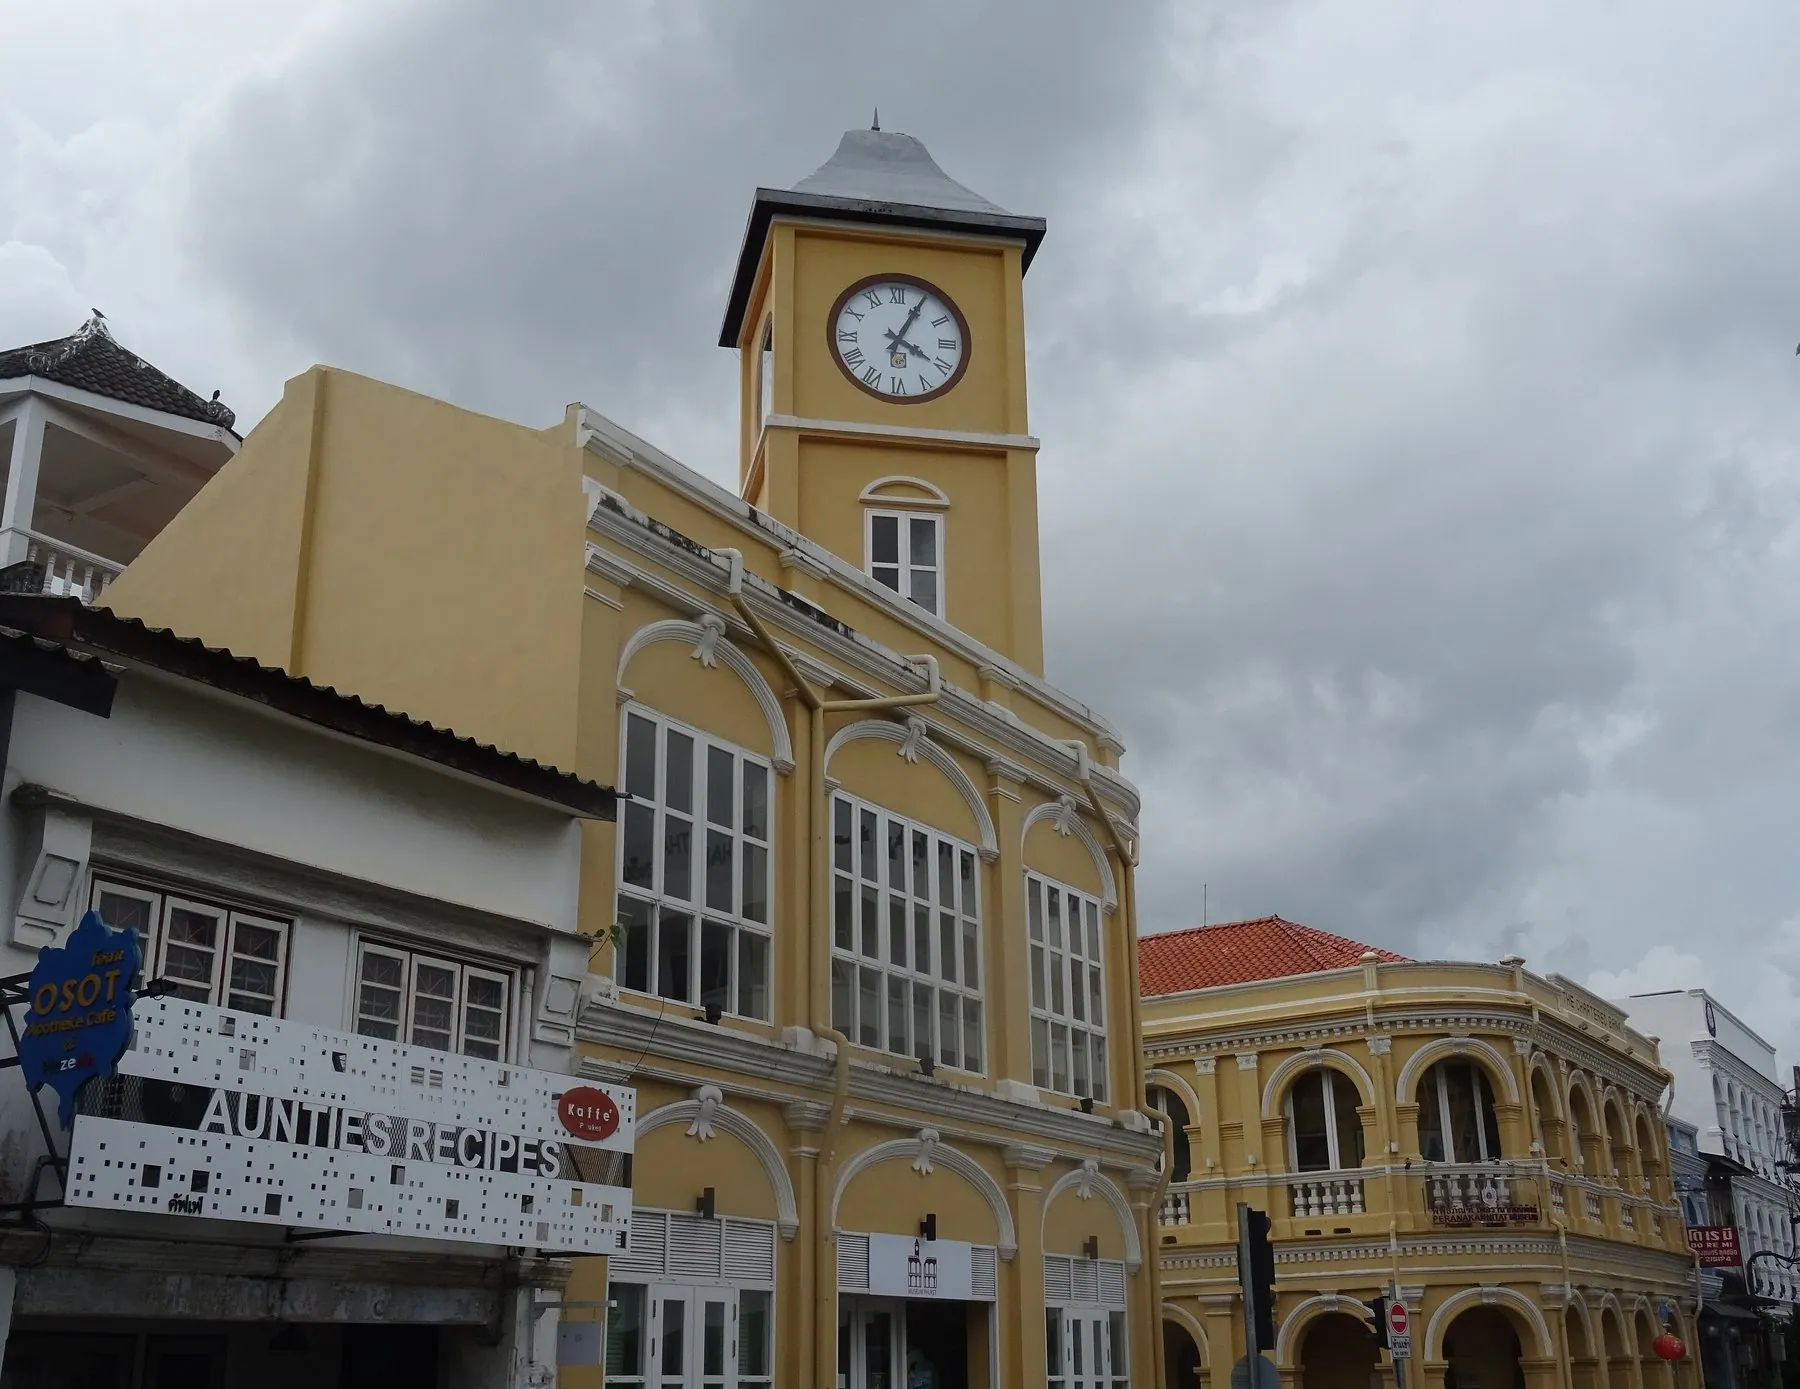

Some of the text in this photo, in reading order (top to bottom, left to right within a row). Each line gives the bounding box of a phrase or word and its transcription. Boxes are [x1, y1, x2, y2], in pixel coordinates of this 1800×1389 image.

[863, 289, 883, 309] XI
[889, 287, 905, 305] XII
[844, 306, 865, 322] X
[931, 315, 950, 328] II
[838, 328, 858, 343] IX
[938, 338, 957, 351] III
[842, 346, 866, 372] VIII
[933, 356, 953, 377] IV
[861, 366, 883, 390] VII
[891, 376, 907, 395] VI
[919, 374, 934, 391] V
[33, 968, 121, 1016] OSOT
[198, 1089, 561, 1179] AUNTIES RECIPES
